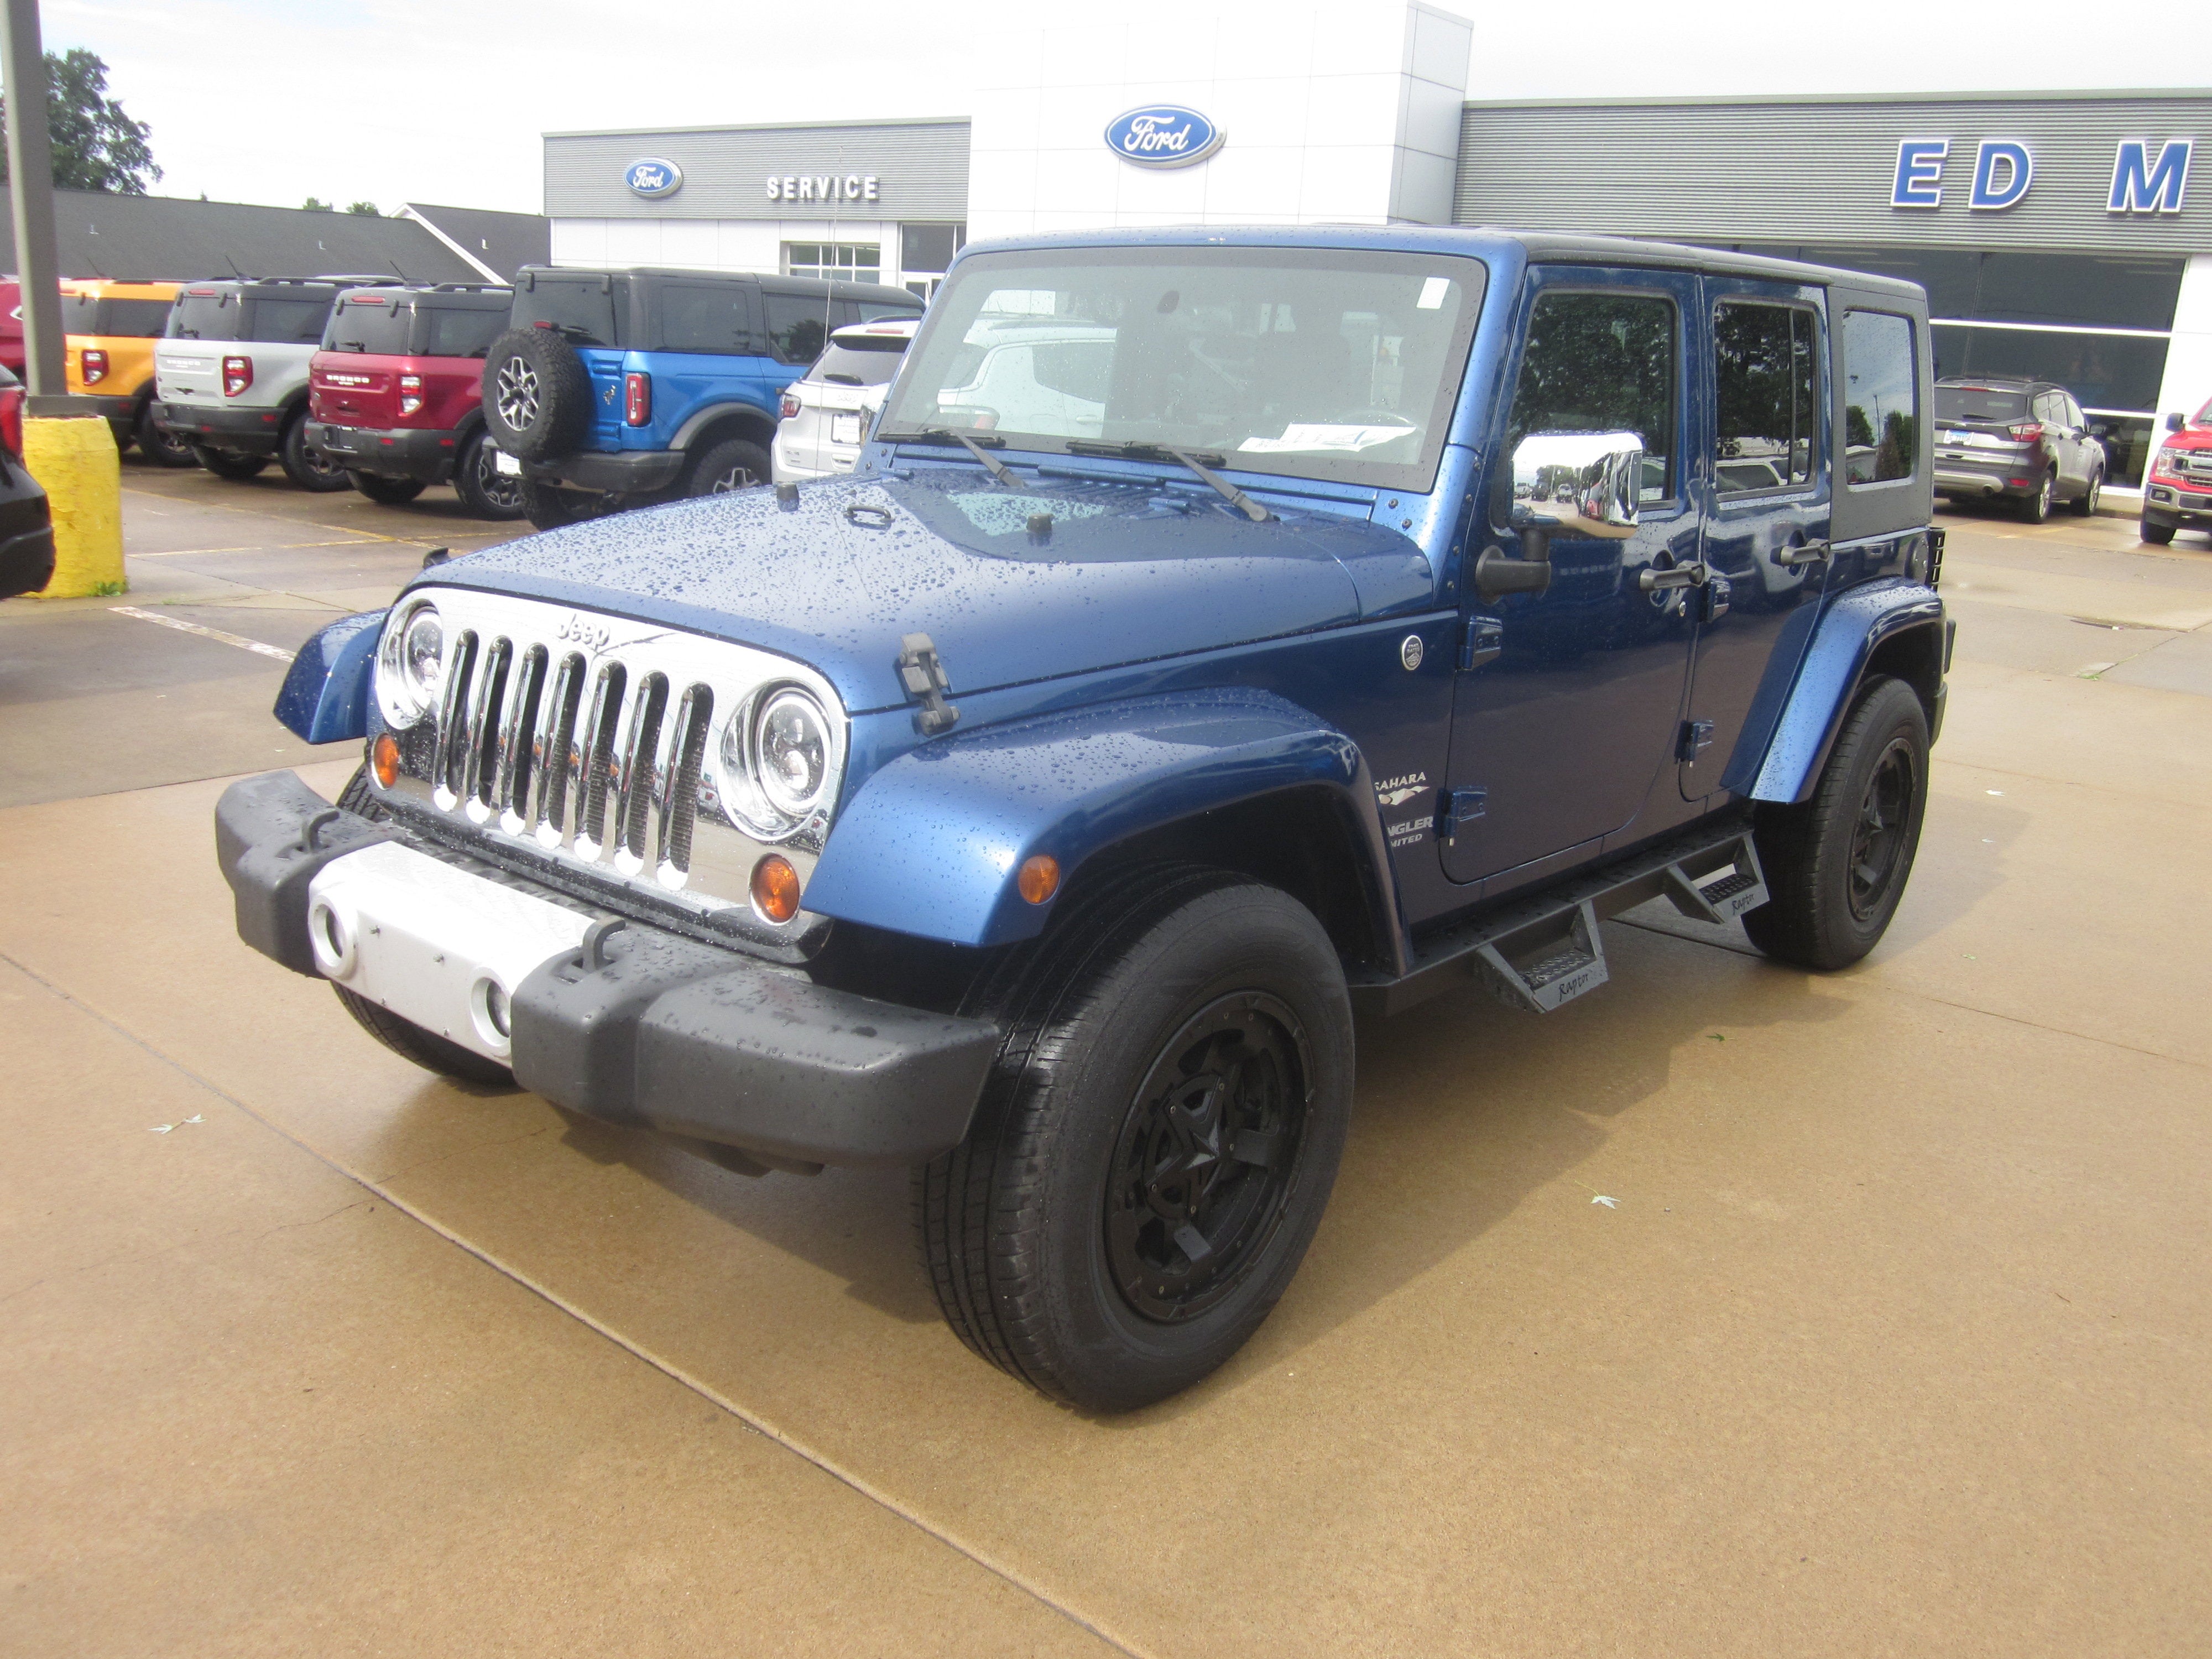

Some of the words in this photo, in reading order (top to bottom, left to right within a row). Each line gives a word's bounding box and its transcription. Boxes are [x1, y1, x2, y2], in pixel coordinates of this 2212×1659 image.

[1124, 115, 1191, 151] Ford
[633, 166, 664, 187] Ford
[766, 175, 877, 200] SERVICE
[1890, 139, 2032, 208] ED
[2106, 139, 2194, 212] M
[326, 374, 370, 383] BRONCO
[556, 613, 611, 651] Jeep
[1731, 892, 1755, 916] Raptor
[1559, 973, 1588, 1002] Raptor
